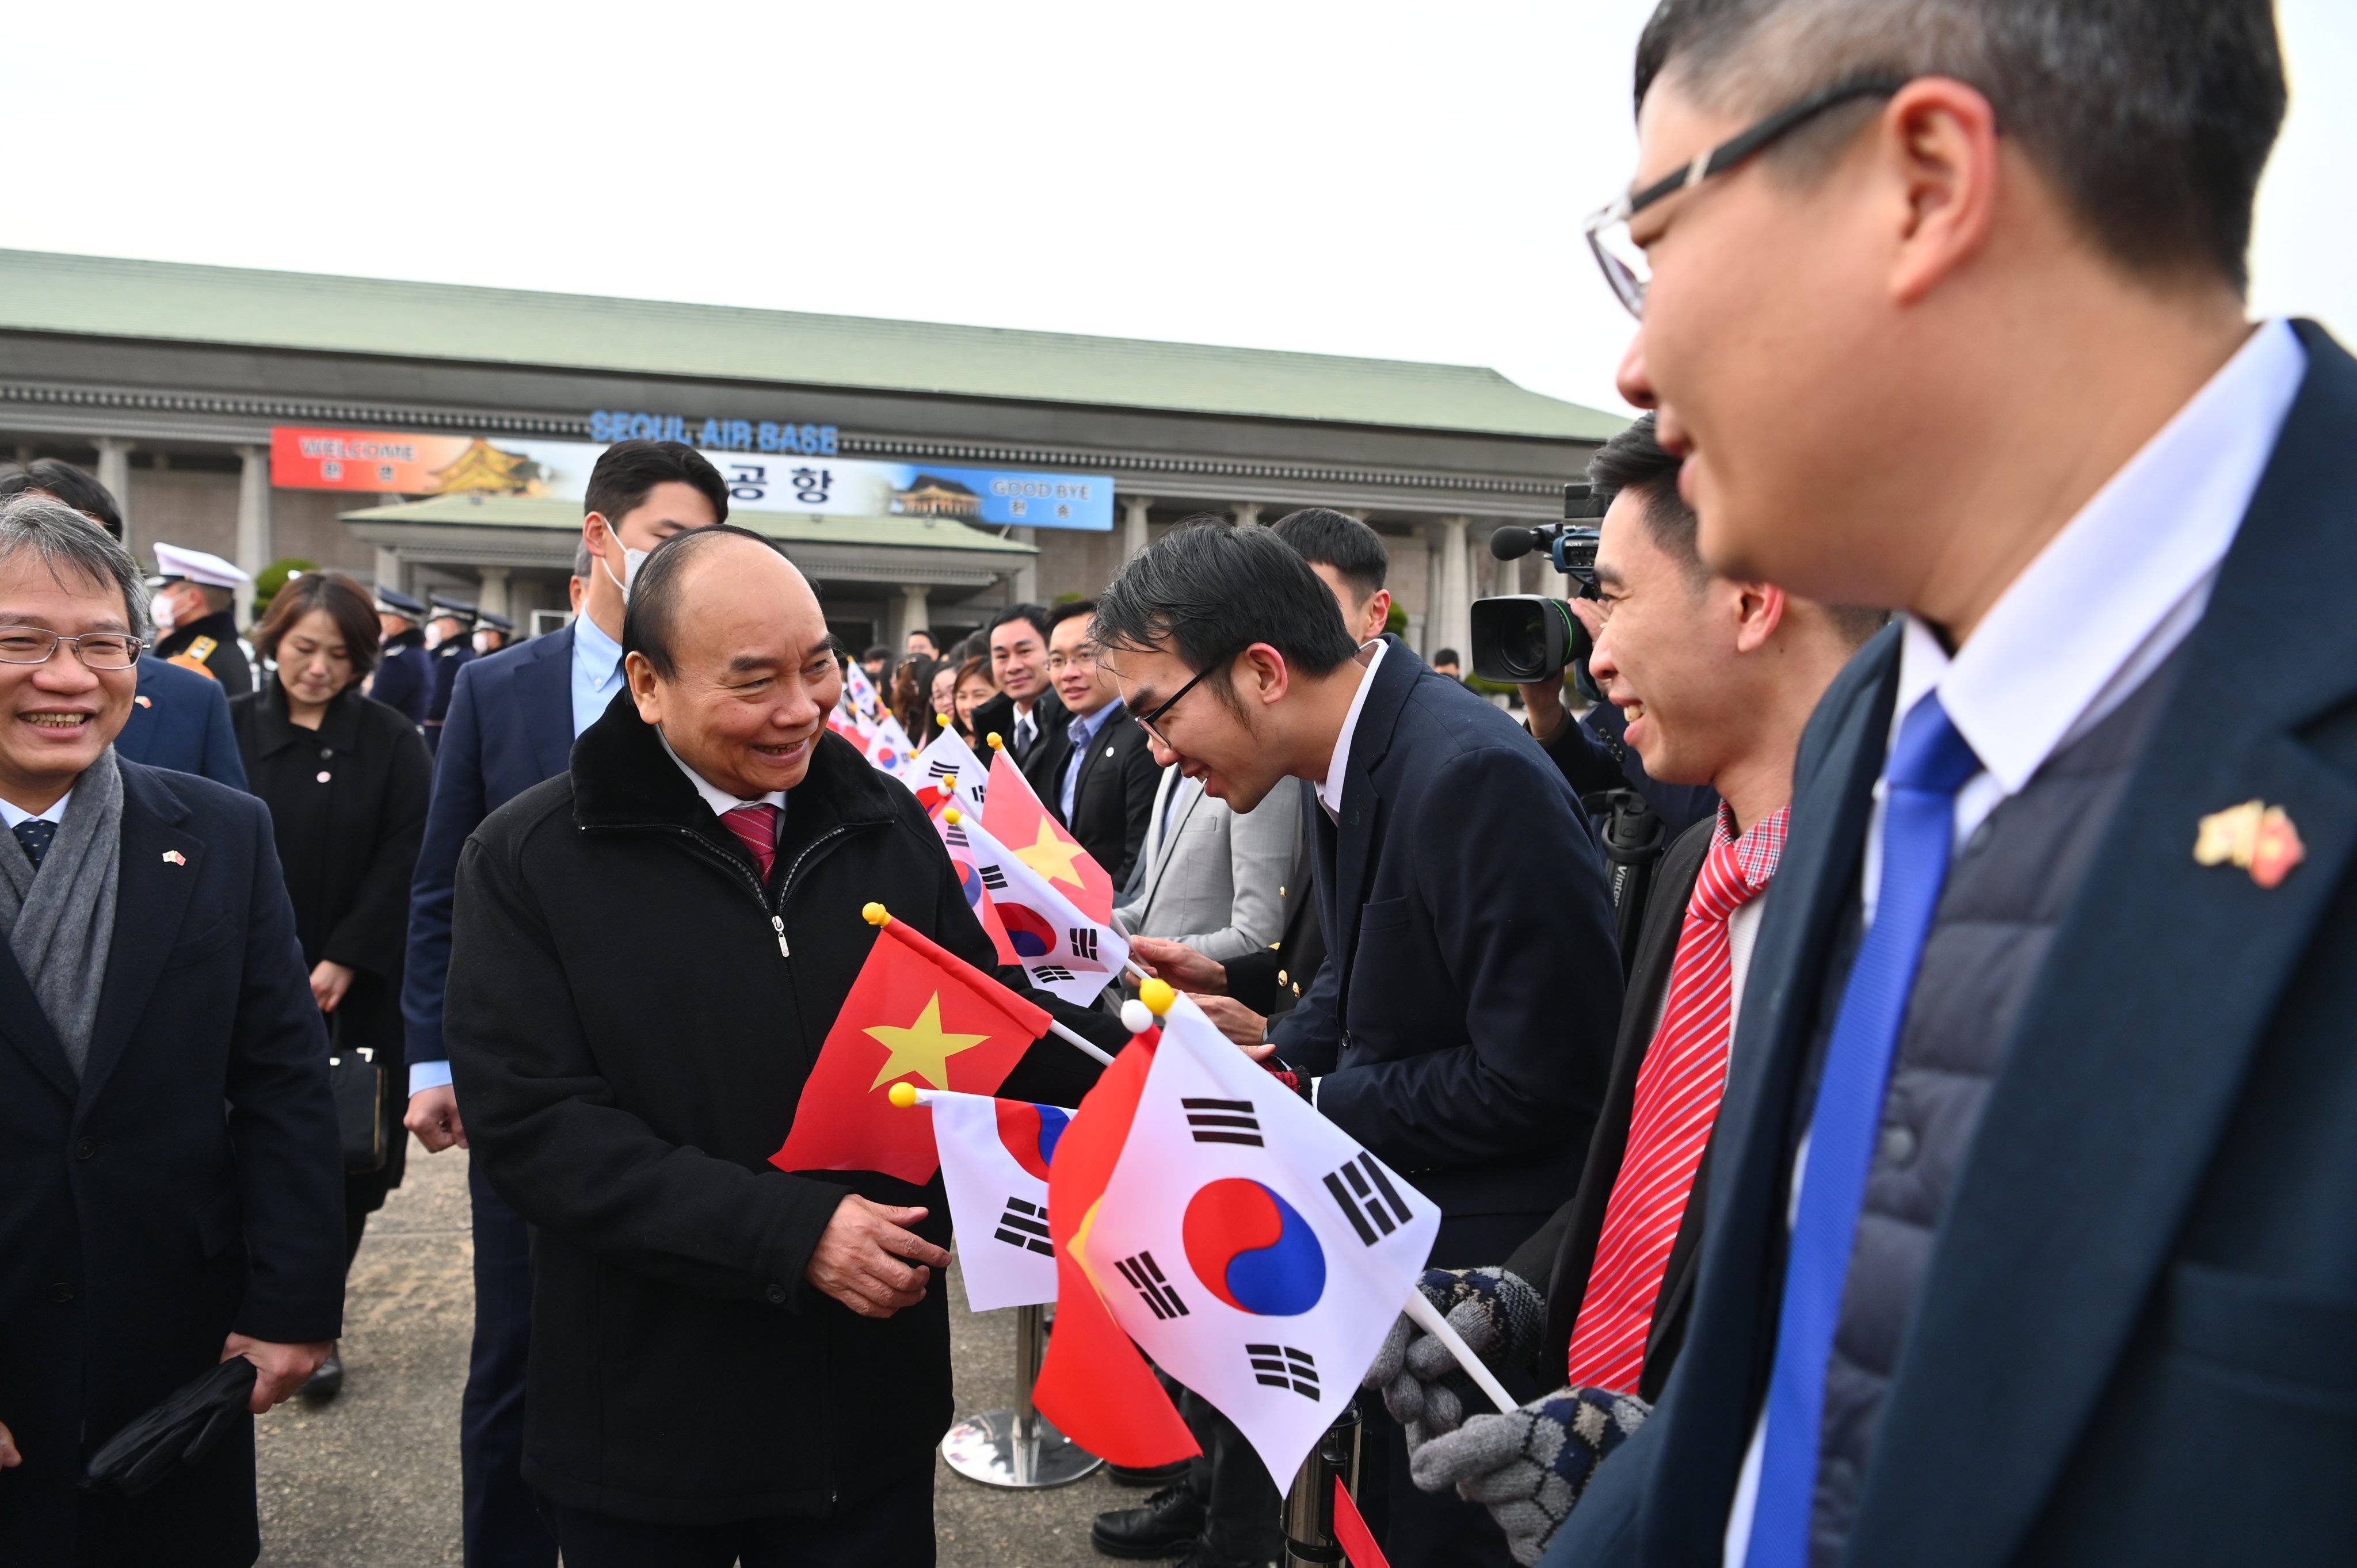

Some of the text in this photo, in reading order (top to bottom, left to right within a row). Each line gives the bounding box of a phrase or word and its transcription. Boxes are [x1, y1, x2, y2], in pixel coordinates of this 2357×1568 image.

[590, 410, 838, 455] SEOUL AIR BASE
[299, 436, 415, 462] WELCOME
[993, 479, 1090, 500] GOOD BYE
